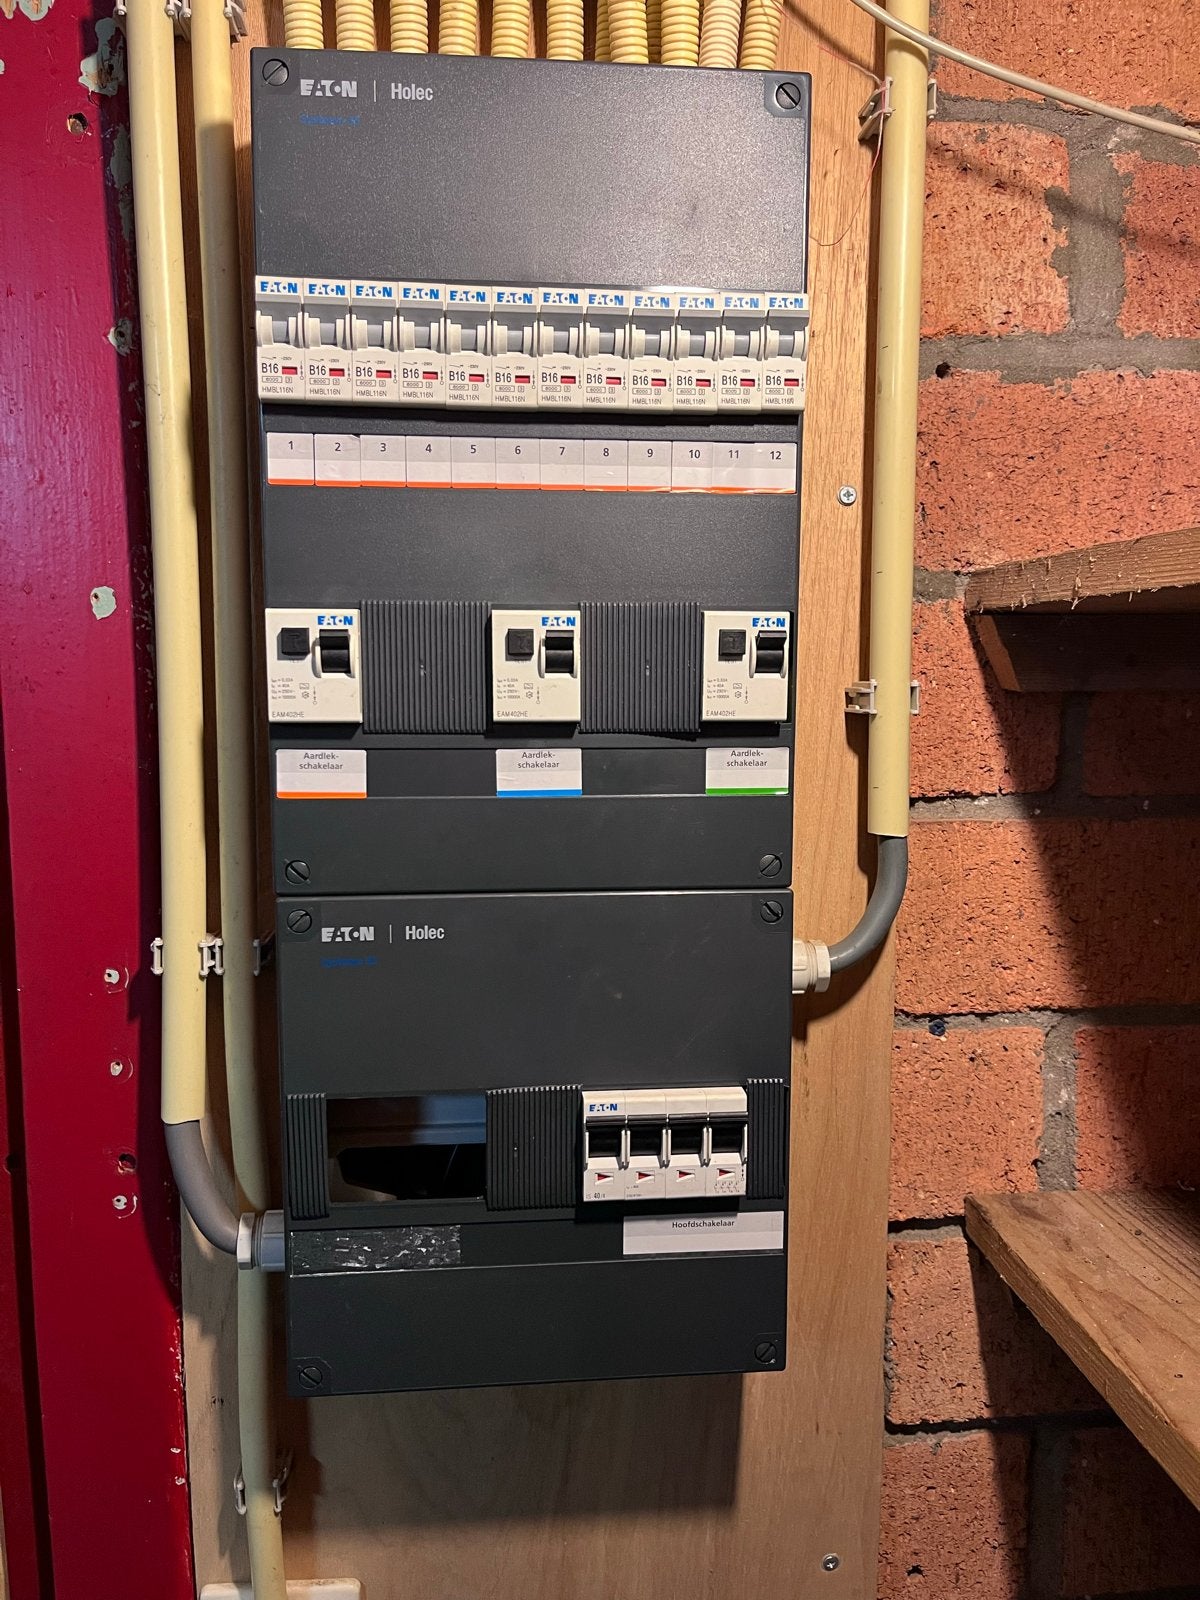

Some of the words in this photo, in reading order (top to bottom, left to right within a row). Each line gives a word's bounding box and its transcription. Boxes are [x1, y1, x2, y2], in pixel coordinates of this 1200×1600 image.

[391, 82, 434, 101] Holec
[261, 363, 279, 373] B16
[309, 365, 326, 375] B16
[356, 366, 373, 377] B16
[402, 368, 419, 379] B16
[449, 371, 465, 381] B16
[495, 372, 511, 383] B16
[542, 372, 558, 383] B16
[586, 374, 603, 384] B16
[632, 375, 648, 385] B16
[676, 376, 693, 386] B16
[722, 375, 738, 386] B16
[766, 376, 782, 386] B16
[288, 441, 294, 450] 1
[335, 442, 341, 452] 2
[380, 442, 386, 452] 3
[425, 444, 432, 453] 4
[470, 444, 477, 454] 5
[515, 445, 521, 455] 6
[559, 447, 565, 456] 7
[603, 448, 609, 457] 8
[647, 448, 654, 458] 9
[689, 450, 700, 459] 10
[729, 450, 740, 459] 11
[770, 451, 782, 460] 12
[405, 925, 445, 940] Holec
[672, 1220, 735, 1229] Hoofdschakelaar
